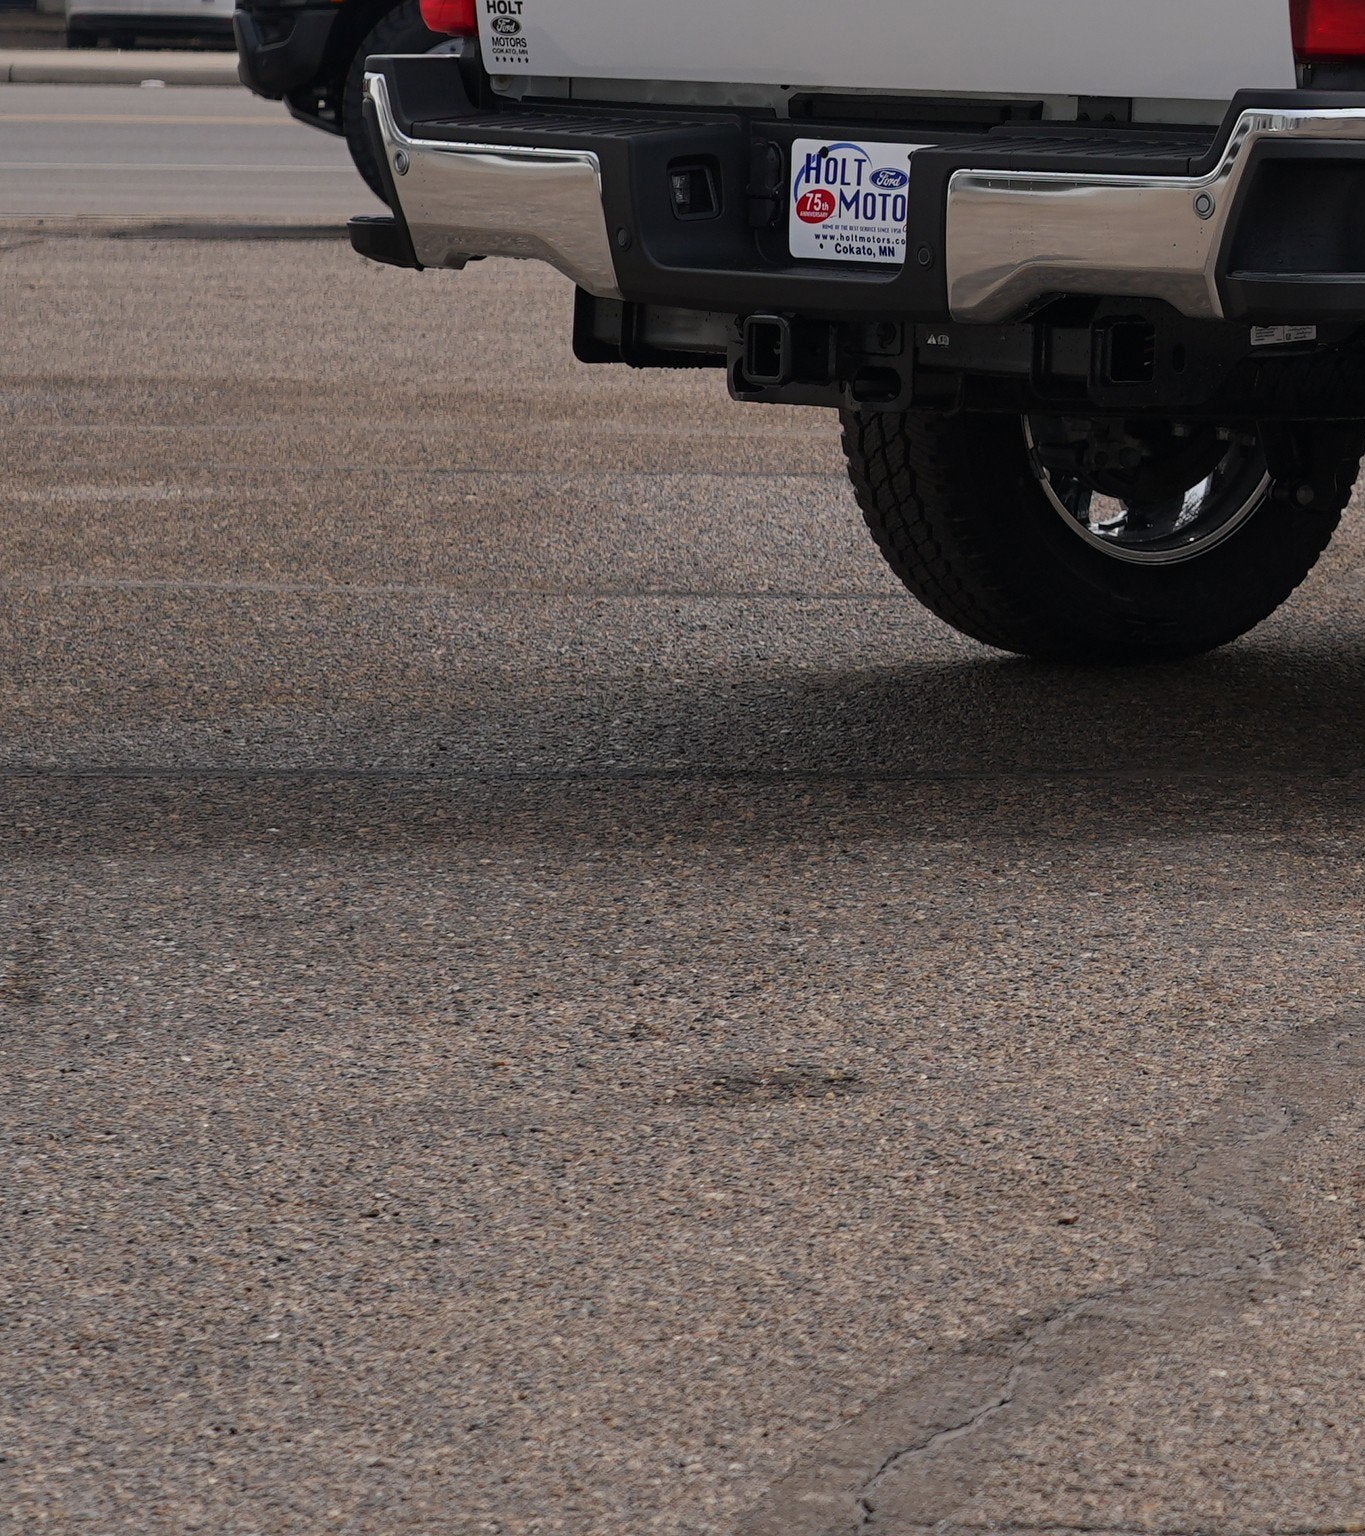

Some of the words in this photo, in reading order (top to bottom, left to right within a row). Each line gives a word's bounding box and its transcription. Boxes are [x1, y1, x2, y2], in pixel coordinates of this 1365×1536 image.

[486, 0, 523, 15] HOLT
[496, 18, 517, 33] Ford
[491, 36, 528, 48] MOTORS
[804, 152, 867, 187] HOLT
[876, 170, 903, 187] Ford
[805, 192, 830, 212] 75th
[839, 187, 907, 222] MOTO
[834, 242, 876, 258] Cokato,
[878, 245, 896, 258] MN
